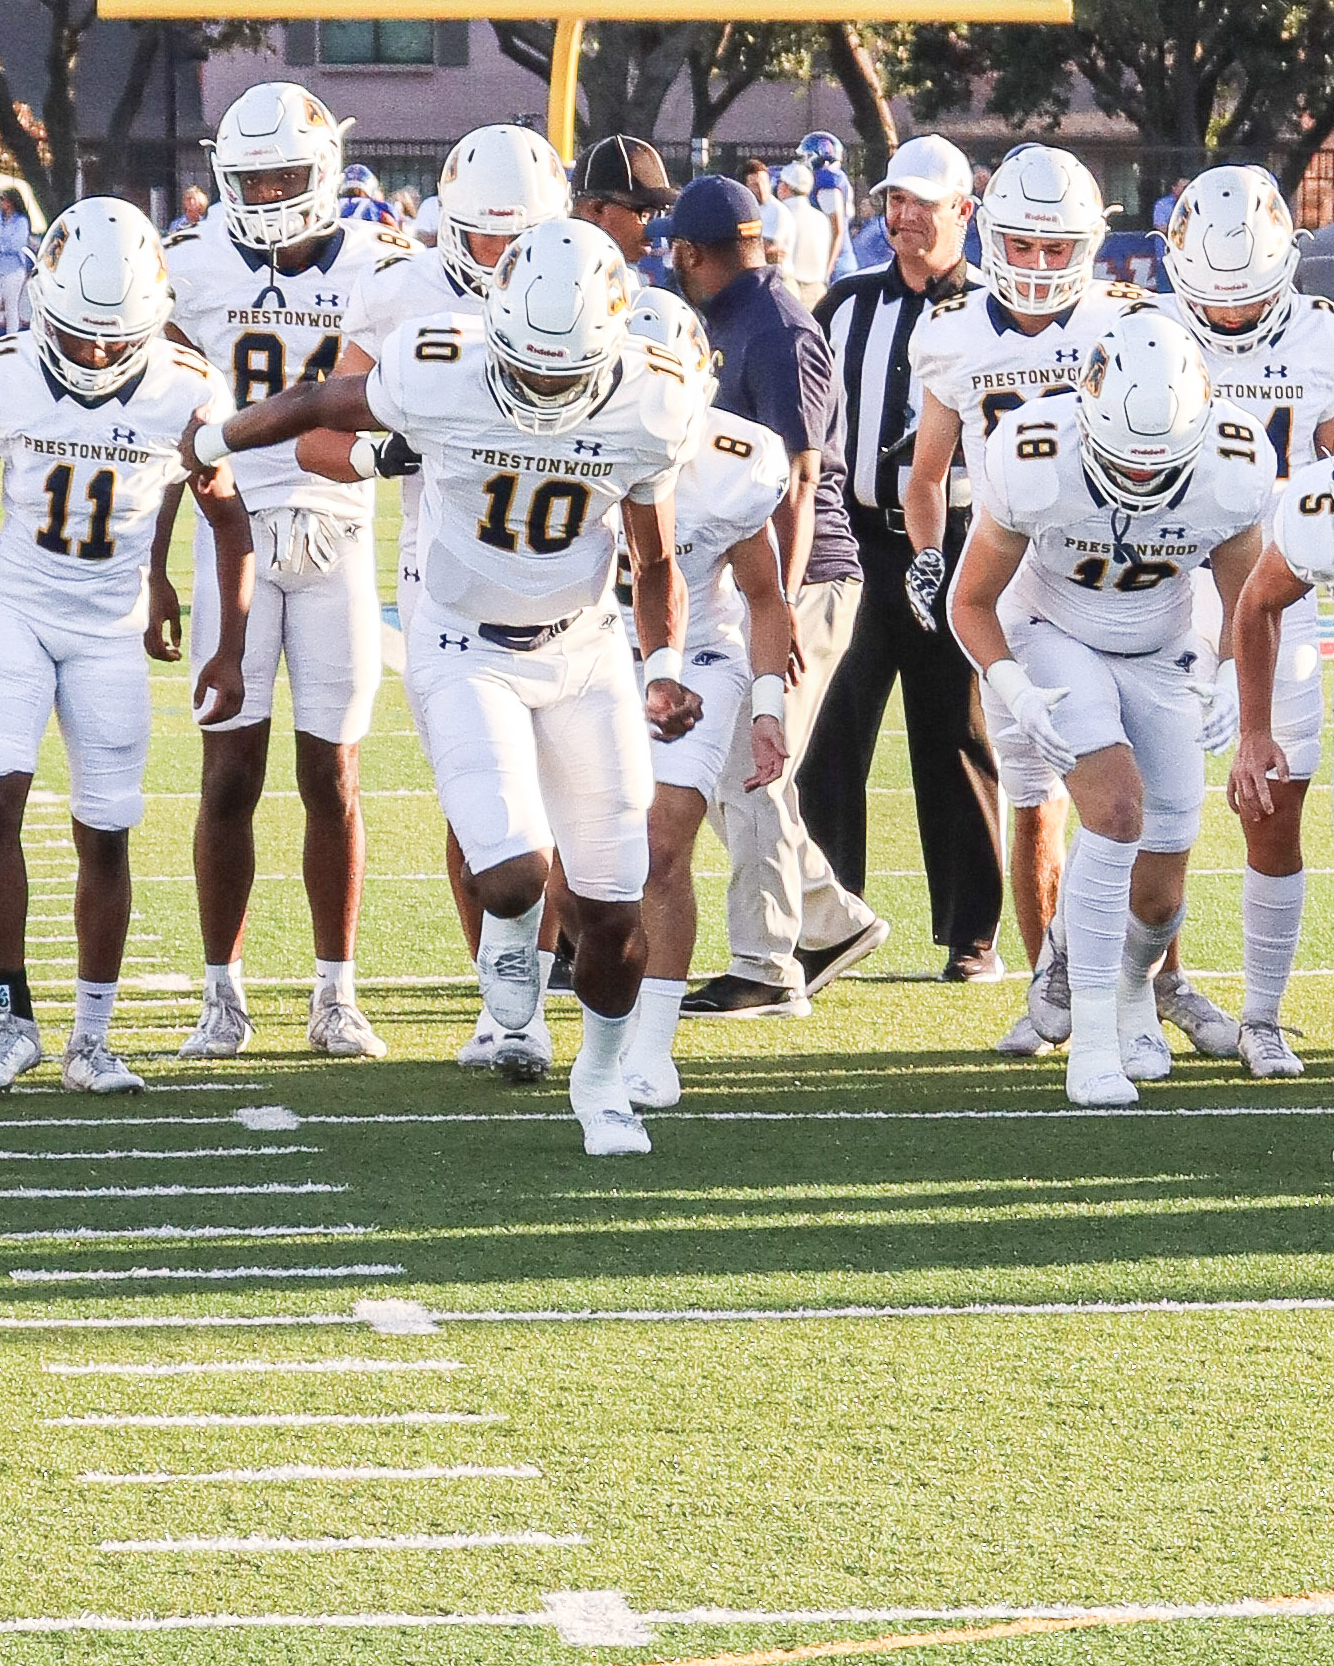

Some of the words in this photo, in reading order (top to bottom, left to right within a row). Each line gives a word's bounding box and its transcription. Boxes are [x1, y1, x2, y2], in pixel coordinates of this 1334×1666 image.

[416, 327, 464, 363] 10
[526, 344, 565, 359] Riddell
[24, 434, 150, 465] PRESTONWOOD
[714, 434, 753, 459] 8
[1017, 421, 1058, 460] 18
[1218, 422, 1256, 465] 18
[471, 448, 615, 478] PRESTONWOOD
[36, 459, 117, 561] 11
[477, 470, 593, 555] 10
[1064, 537, 1198, 556] PRESNWOOD
